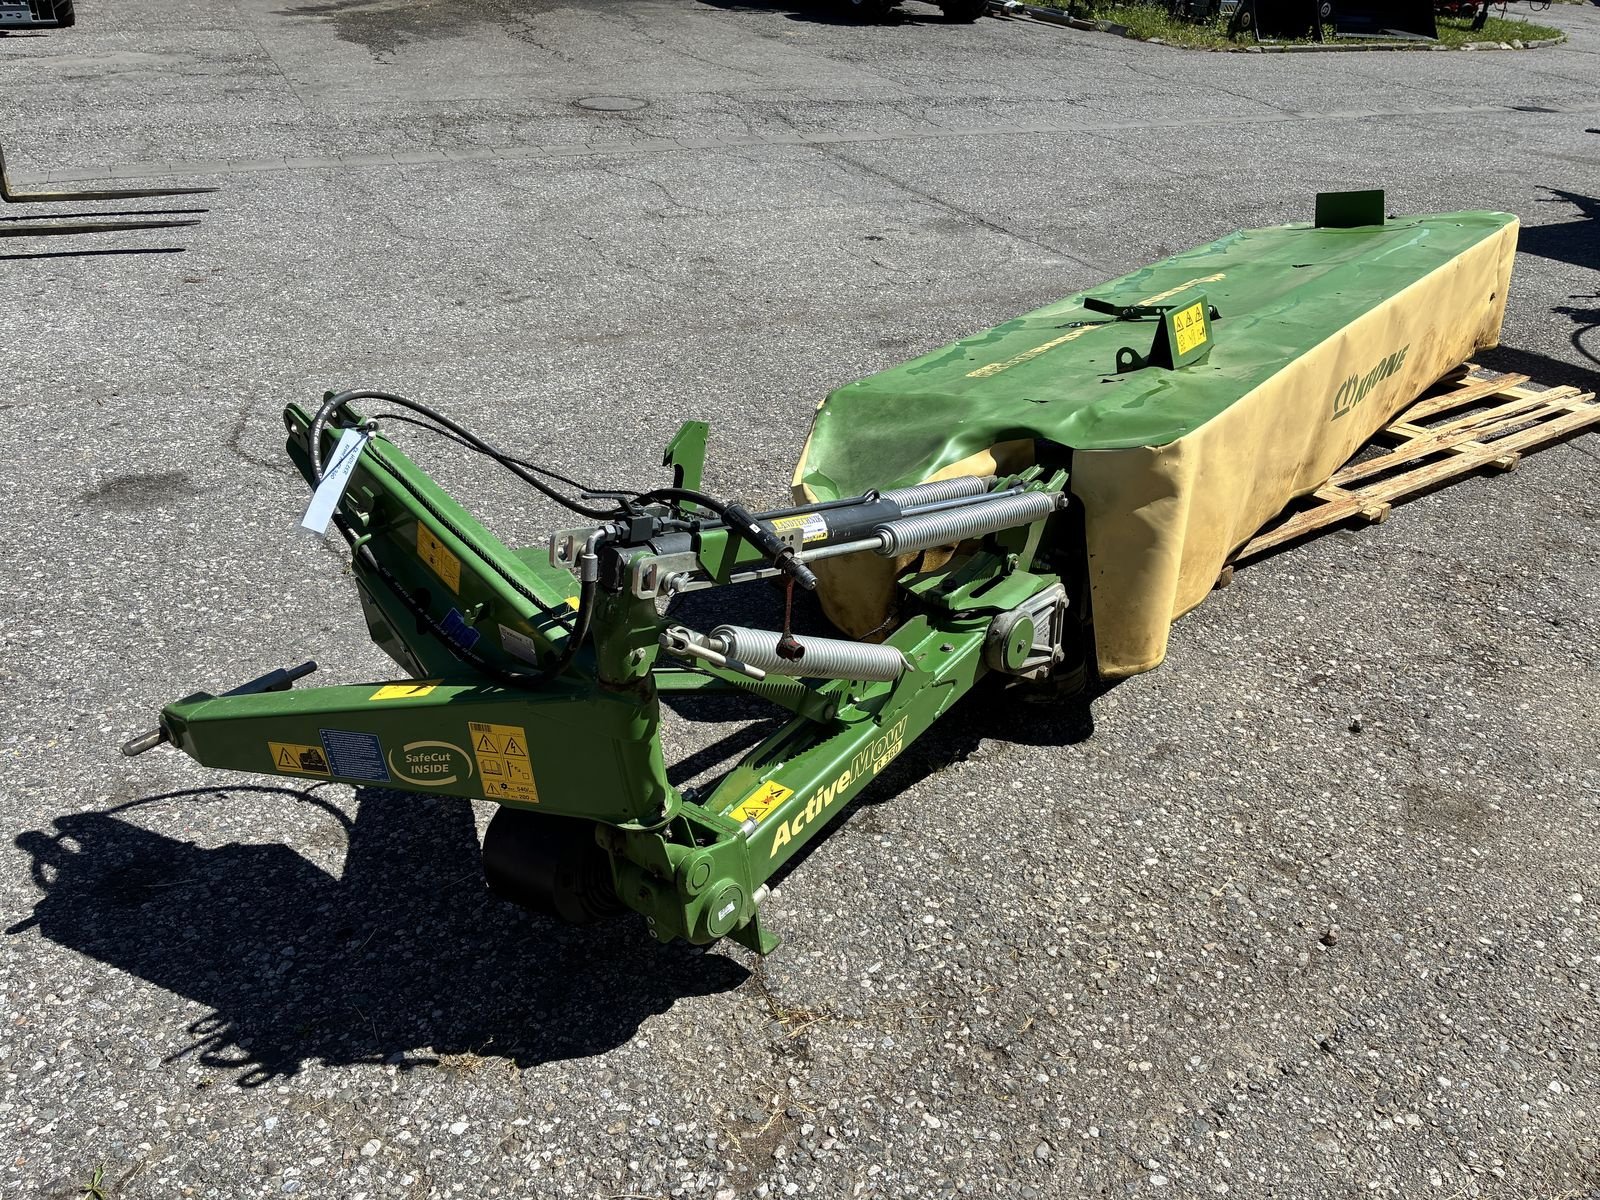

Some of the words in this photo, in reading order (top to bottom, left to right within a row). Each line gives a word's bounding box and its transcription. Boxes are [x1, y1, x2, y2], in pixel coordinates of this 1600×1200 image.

[1351, 343, 1411, 409] KRONE
[405, 752, 451, 763] SafeCut
[411, 764, 449, 774] INSIDE
